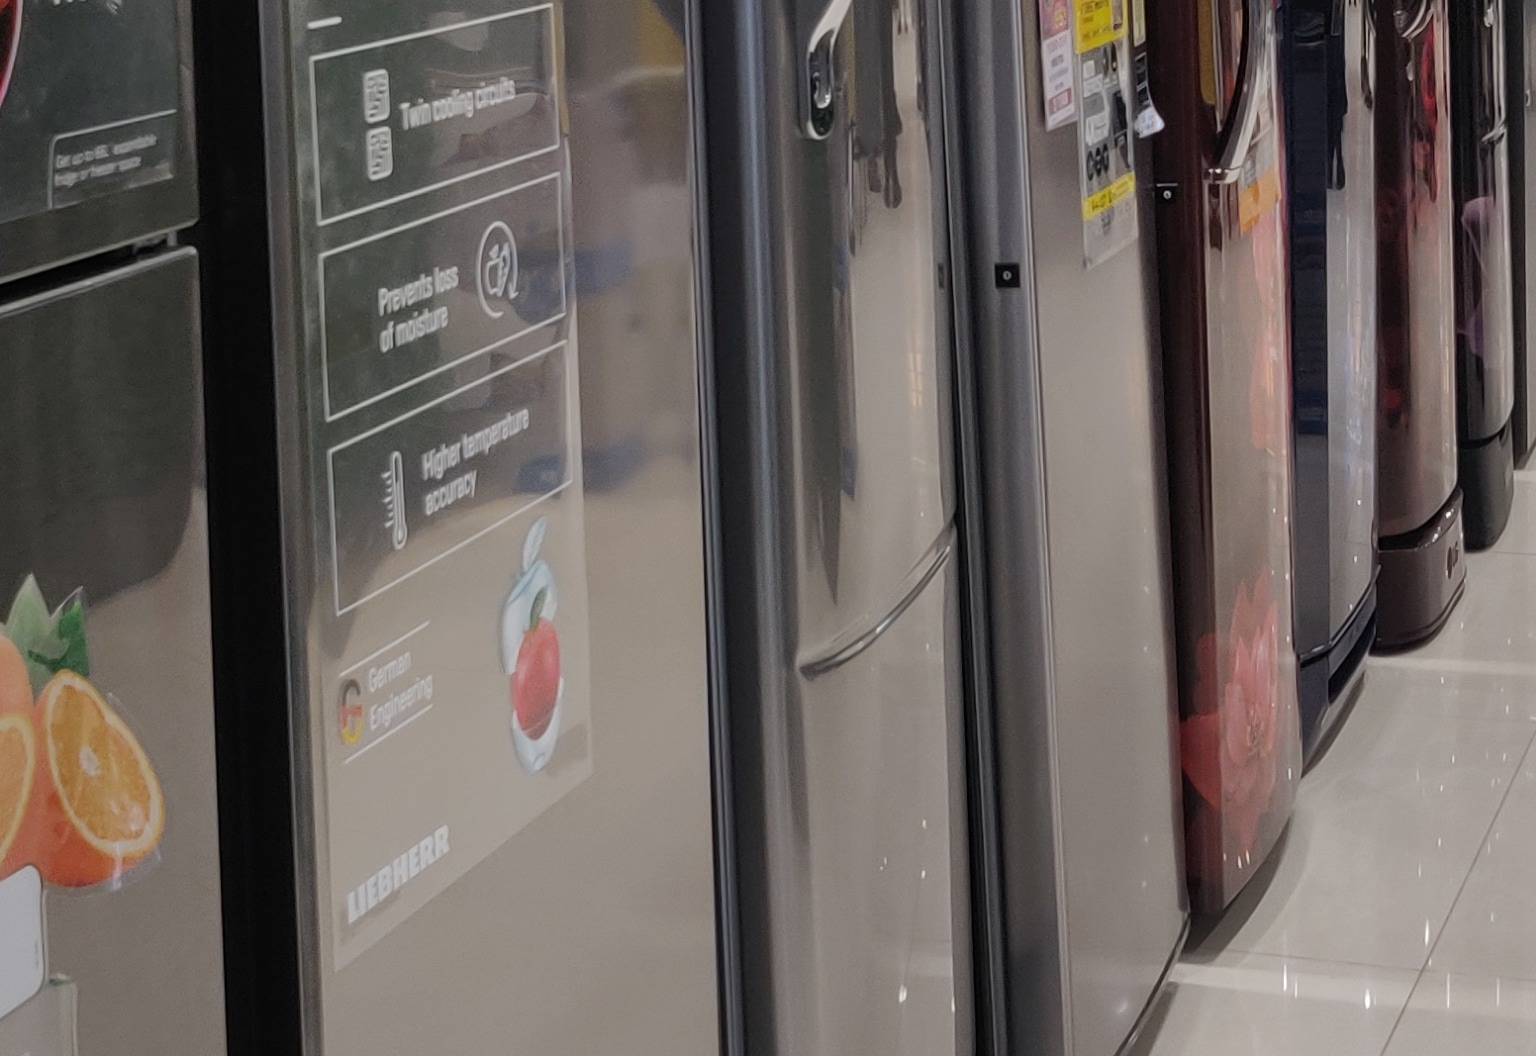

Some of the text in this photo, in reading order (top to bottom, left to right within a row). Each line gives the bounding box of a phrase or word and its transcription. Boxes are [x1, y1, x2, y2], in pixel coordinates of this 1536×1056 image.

[399, 76, 516, 131] Twin cooling circuits
[378, 265, 460, 317] Prevents loss
[378, 304, 449, 354] of moisture
[421, 407, 531, 481] Higher temperature
[424, 468, 479, 517] accuracy
[368, 650, 412, 693] German
[370, 673, 434, 731] Engineering
[346, 823, 452, 926] LIEBHERR
